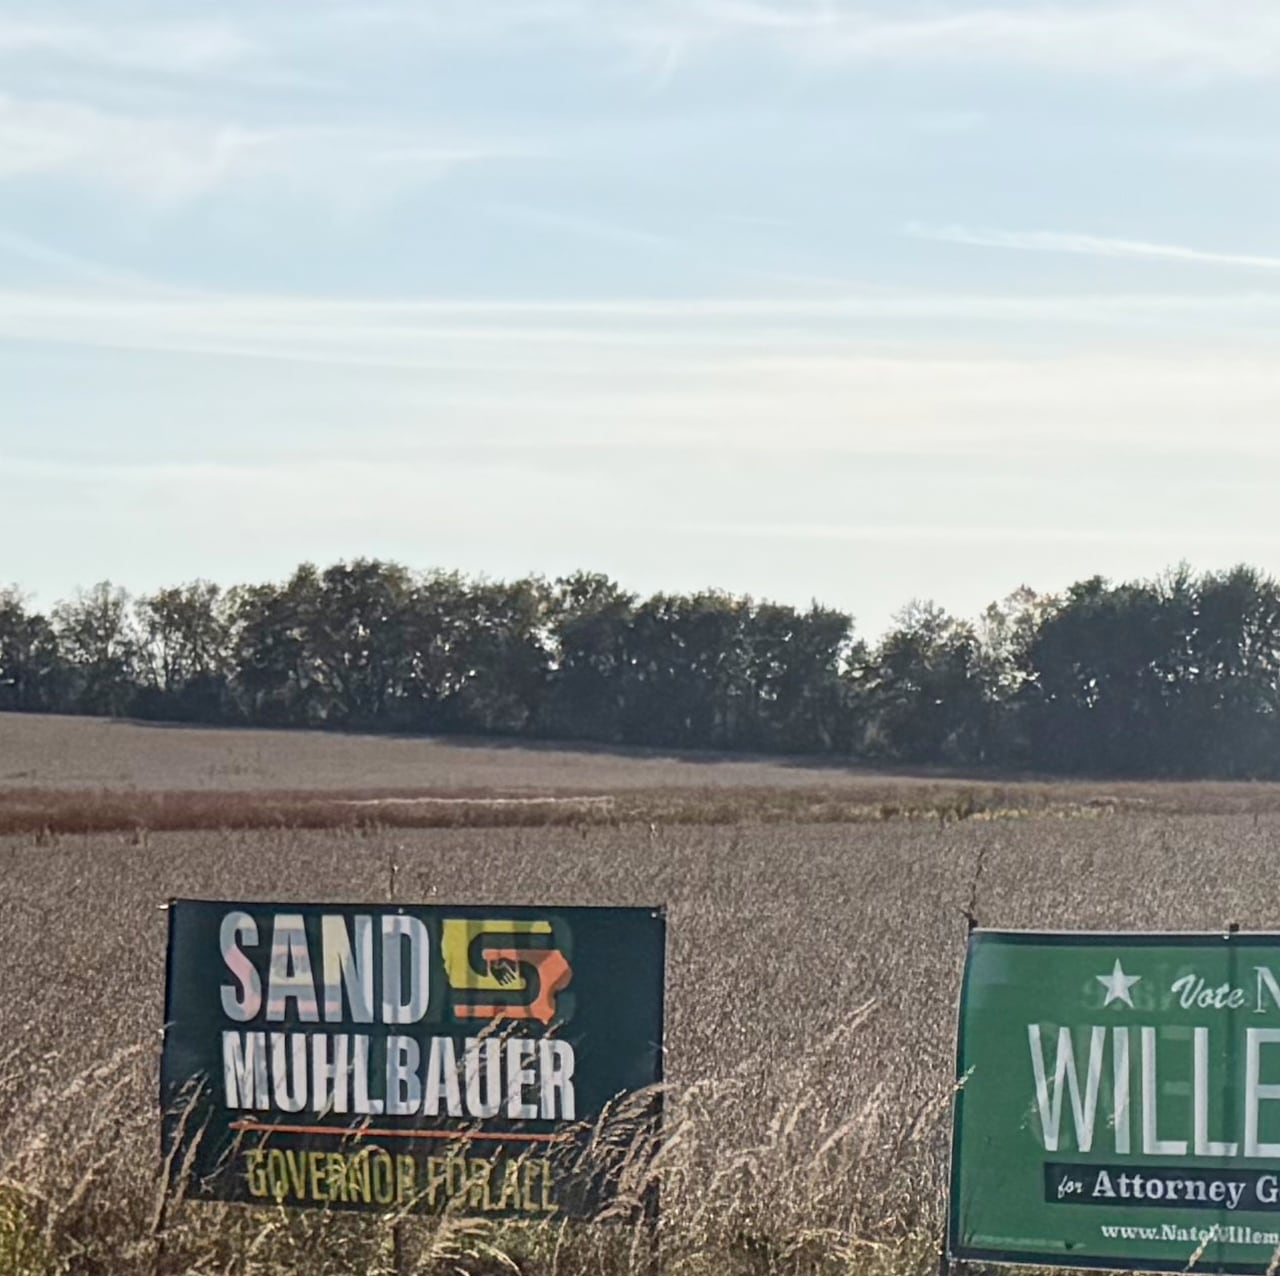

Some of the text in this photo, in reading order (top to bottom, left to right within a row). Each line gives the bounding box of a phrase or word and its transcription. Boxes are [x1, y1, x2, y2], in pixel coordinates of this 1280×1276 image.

[220, 910, 430, 1024] SAND
[1171, 974, 1245, 1009] Vote
[222, 1031, 576, 1121] MUHLBAUER
[247, 1149, 417, 1204] GOVERNOR
[427, 1155, 491, 1210] FOR
[1057, 1175, 1084, 1199] for
[1092, 1170, 1247, 1208] Attorney
